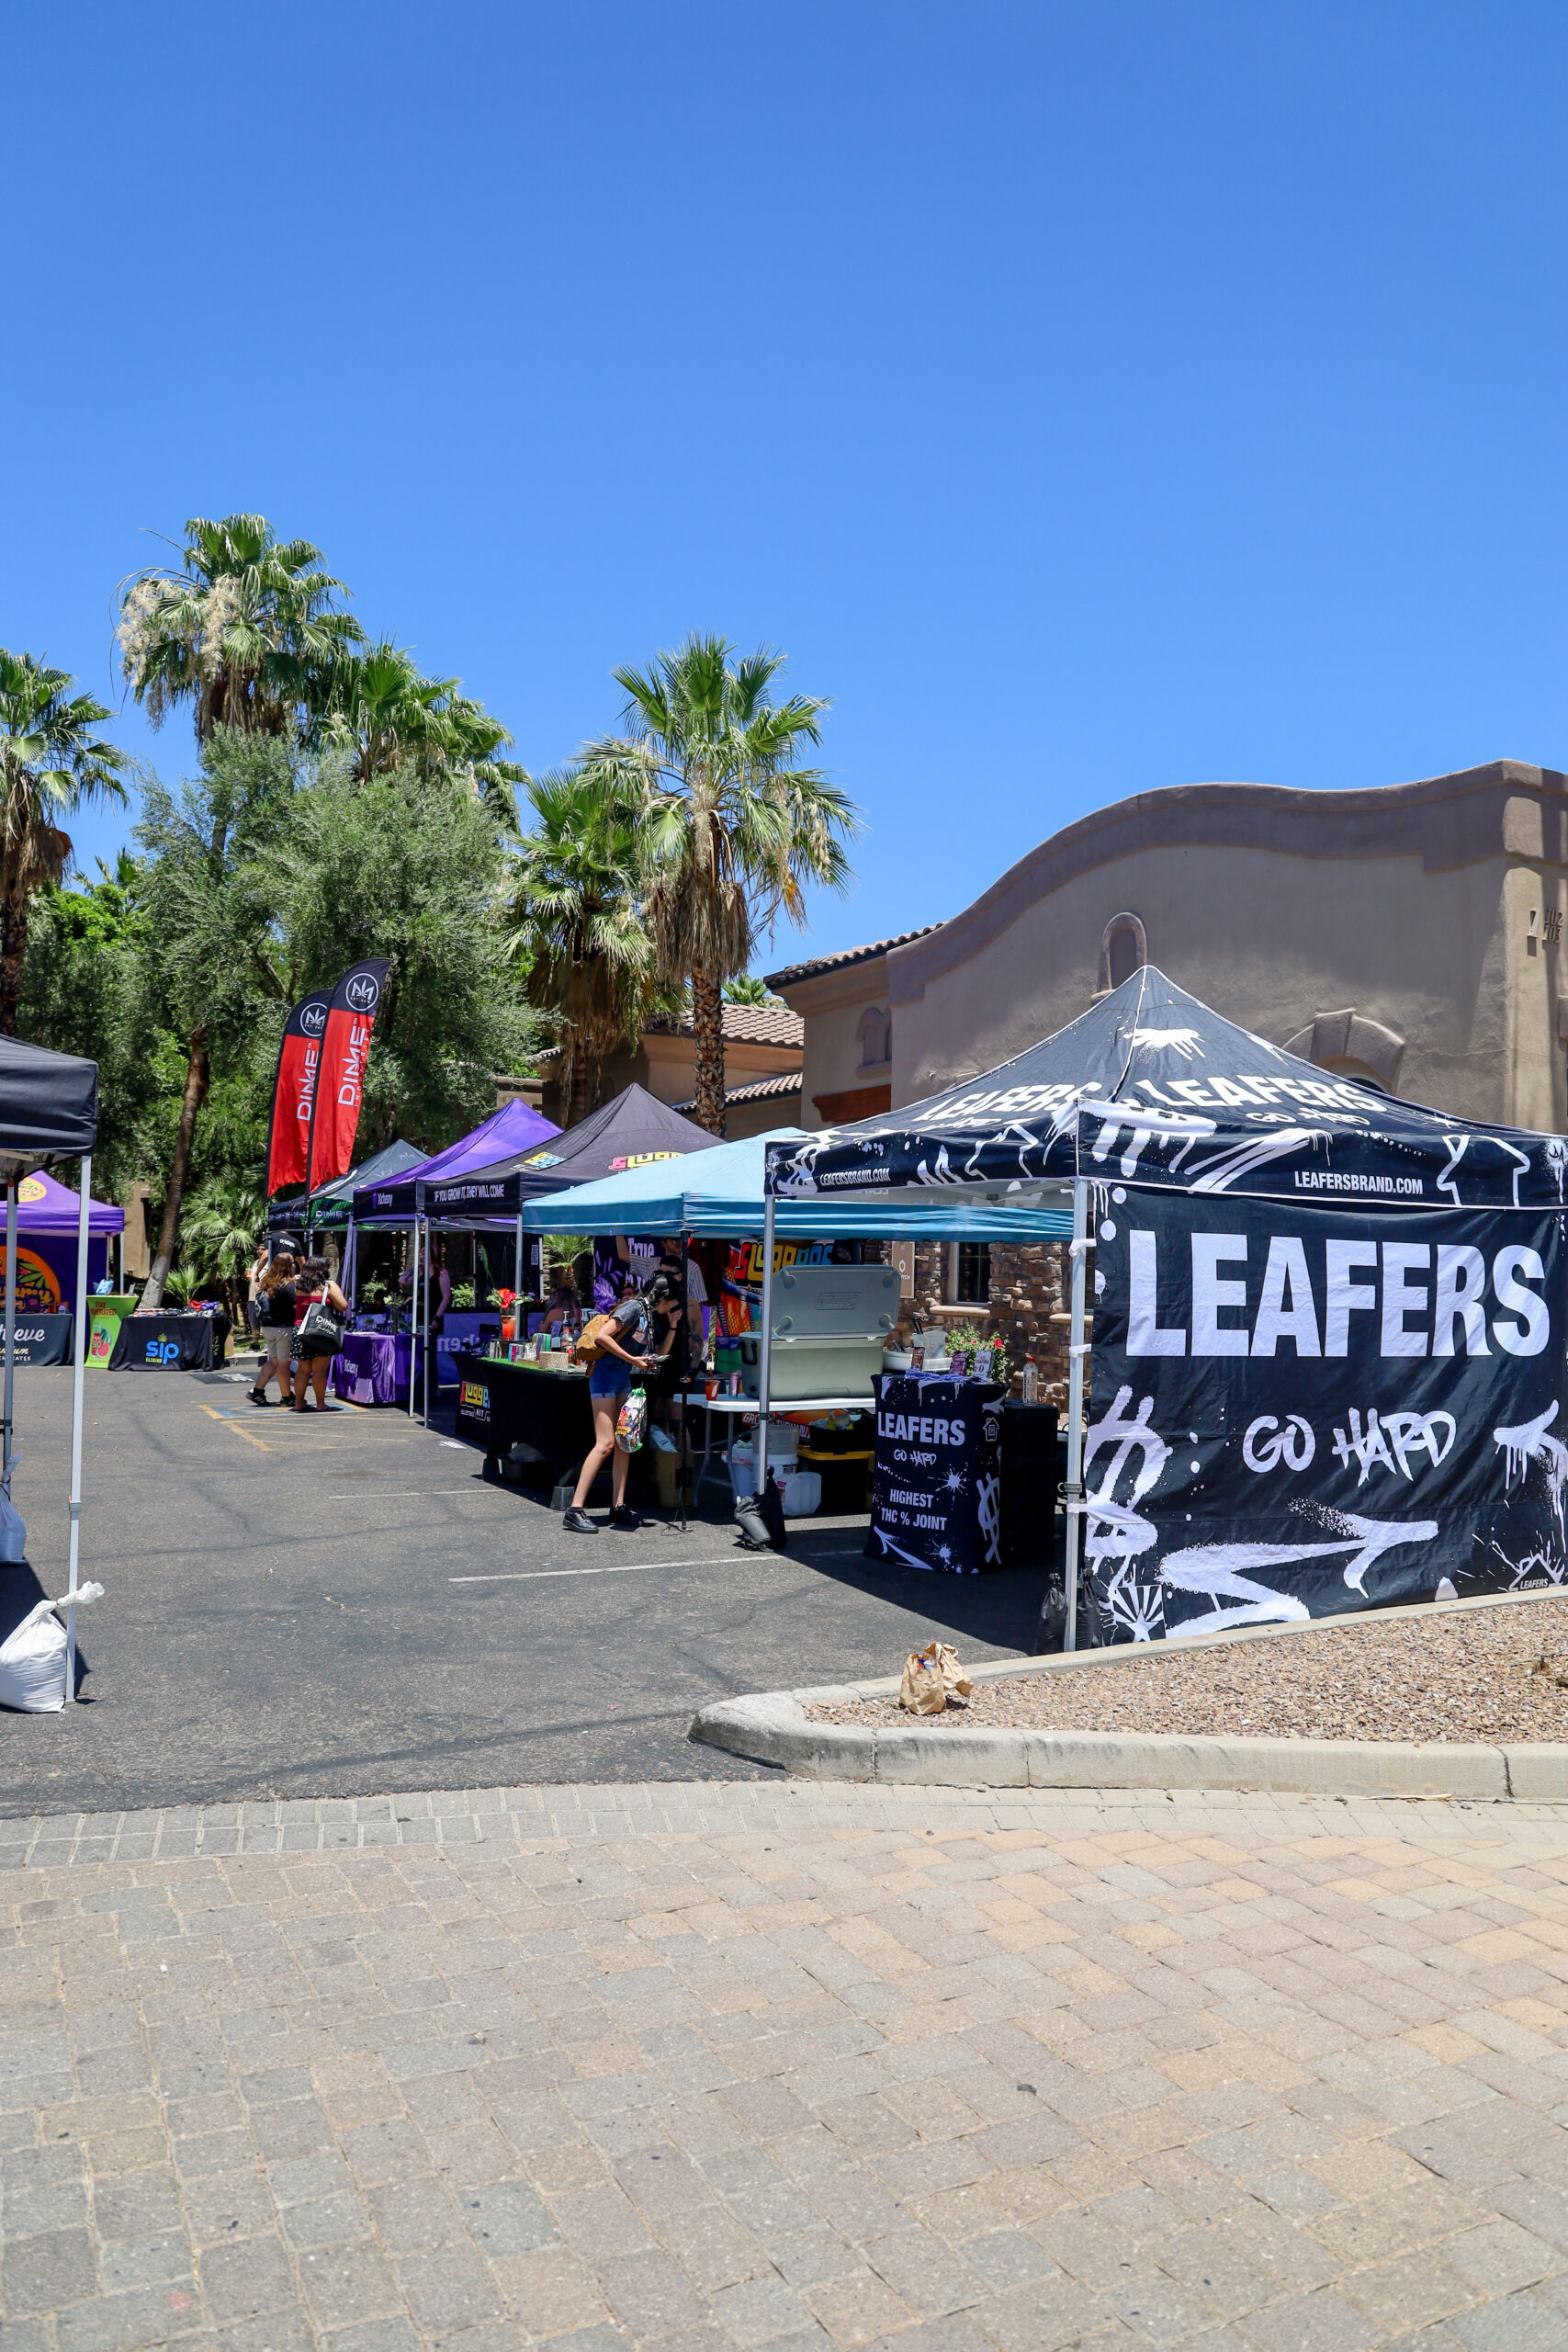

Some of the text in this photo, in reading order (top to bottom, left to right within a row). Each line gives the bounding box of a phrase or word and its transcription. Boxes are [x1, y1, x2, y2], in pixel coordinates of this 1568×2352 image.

[1135, 1075, 1387, 1113] LEAFERS
[1246, 1113, 1297, 1123] GO
[819, 1168, 891, 1187] LEAFERSBRAND.COM
[1294, 1170, 1424, 1195] LEAFERSBRAND.COM
[439, 1189, 447, 1202] YOU
[447, 1186, 461, 1201] GROW
[466, 1185, 478, 1199] THEY
[478, 1184, 490, 1198] WILL
[490, 1183, 505, 1198] COME
[627, 1238, 655, 1258] True
[1125, 1228, 1551, 1358] LEAFERS
[145, 1340, 180, 1365] sip
[877, 1410, 966, 1446] LEAFERS
[893, 1449, 937, 1468] GO HARD
[1242, 1408, 1458, 1487] GO HARD
[889, 1488, 934, 1510] HIGHEST
[881, 1507, 948, 1532] THC % JOINT
[1519, 1577, 1550, 1590] LEAFERS
